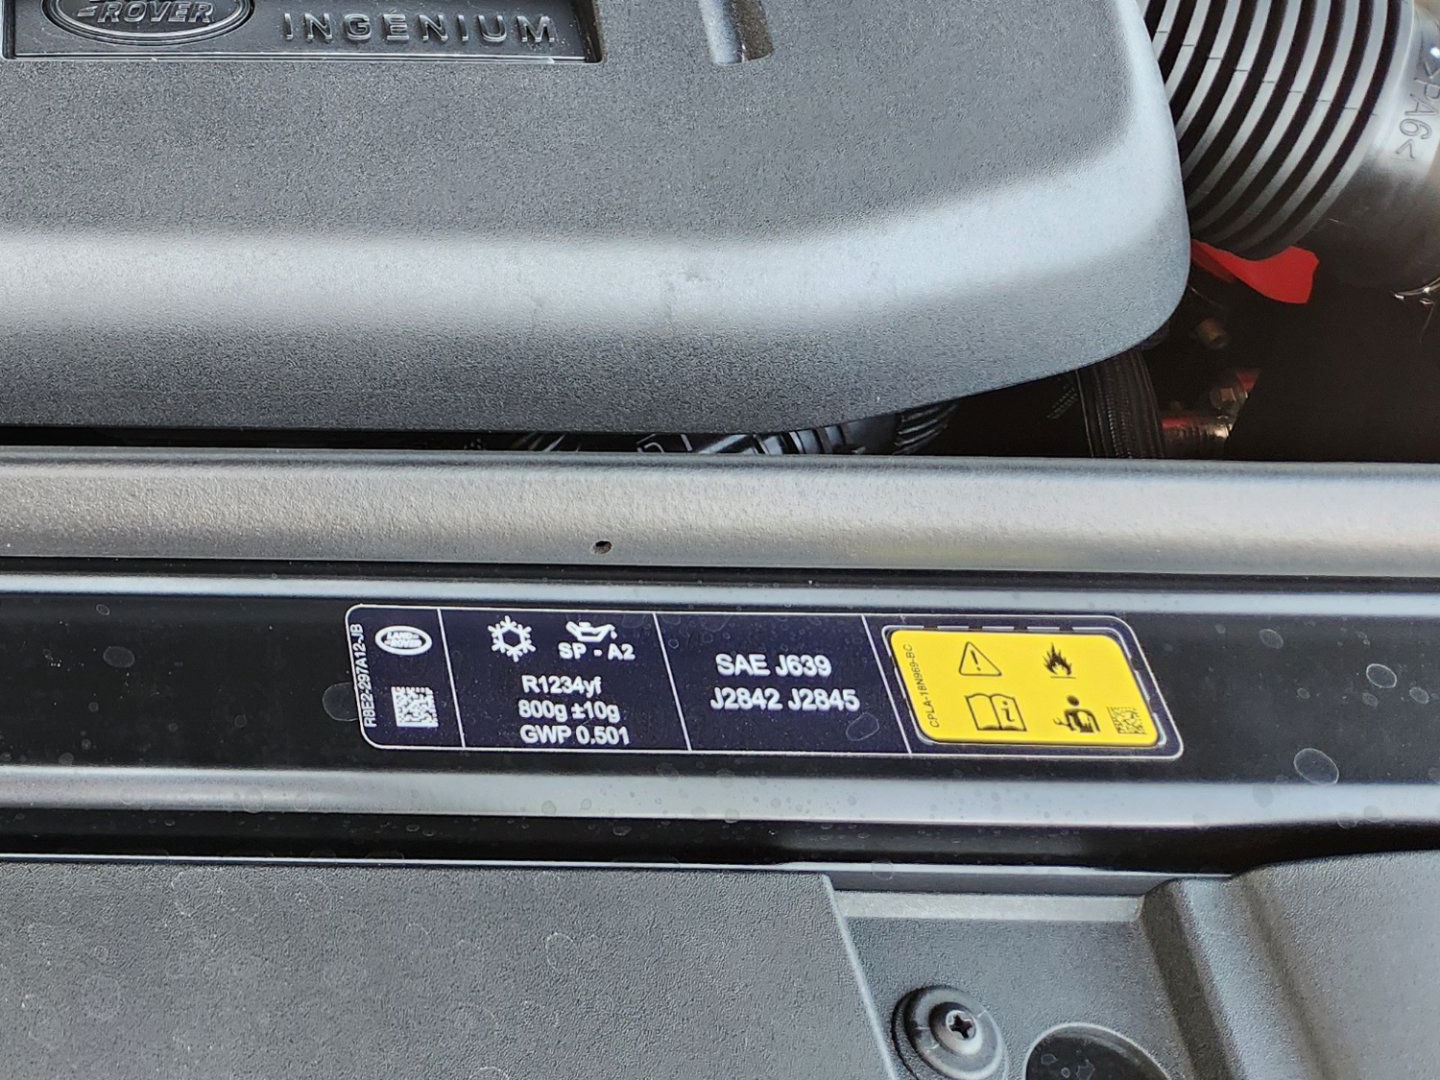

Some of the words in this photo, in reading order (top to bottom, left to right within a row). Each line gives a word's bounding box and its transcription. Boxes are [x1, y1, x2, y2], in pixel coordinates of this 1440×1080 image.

[283, 11, 557, 43] INGENIUM
[558, 643, 587, 659] SP
[607, 644, 636, 660] A2
[715, 653, 771, 676] SAE
[775, 654, 832, 677] J639
[521, 675, 602, 697] R1234yf
[710, 687, 783, 710] J2842
[788, 688, 860, 712] J2845
[518, 700, 568, 722] 800g
[571, 701, 620, 723] ±10g
[519, 725, 572, 744] GWP
[575, 726, 630, 745] 0.501
